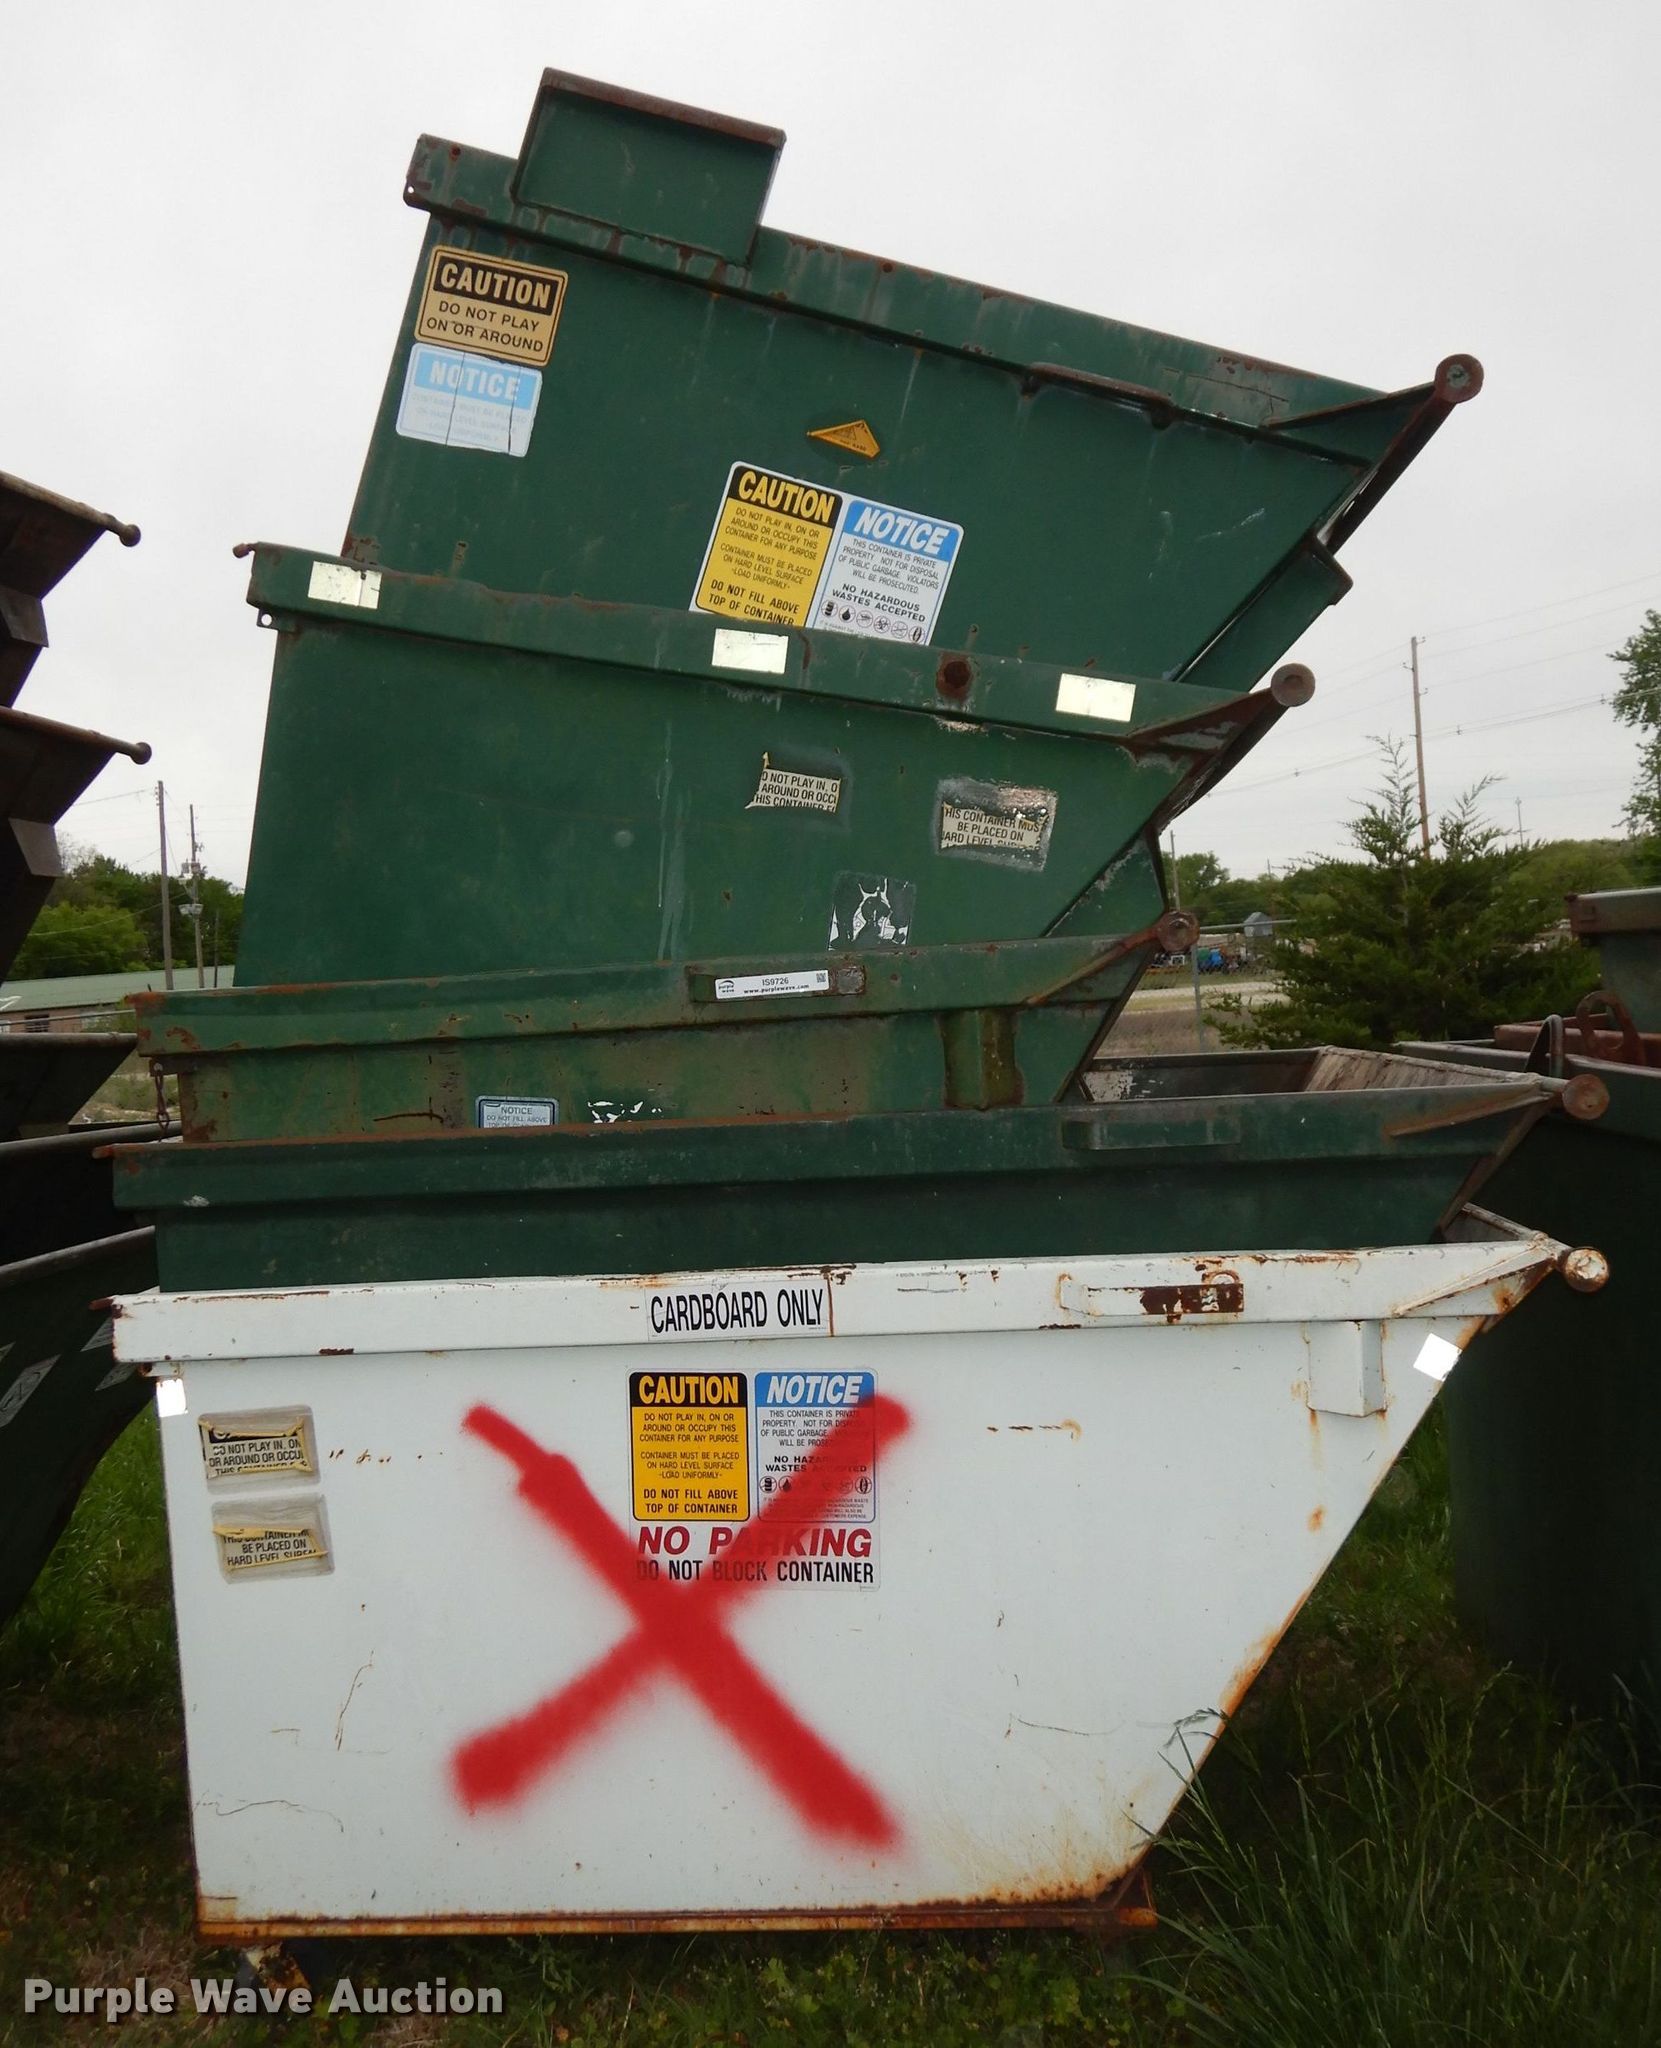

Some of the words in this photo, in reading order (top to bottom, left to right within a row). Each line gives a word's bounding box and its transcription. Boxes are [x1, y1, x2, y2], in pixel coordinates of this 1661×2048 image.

[440, 263, 551, 308] CAUTION
[439, 301, 460, 315] DO
[465, 306, 497, 323] NOT
[501, 314, 539, 332] PLAY
[426, 317, 448, 332] ON
[453, 323, 475, 337] OR
[479, 329, 543, 352] AROUND
[429, 360, 521, 401] NOTICE
[738, 470, 835, 523] CAUTION
[735, 507, 746, 516] DO
[748, 511, 763, 521] NOT
[765, 515, 782, 526] PLAY
[796, 525, 807, 535] ON
[809, 528, 820, 539] OR
[854, 506, 950, 555] NOTICE
[725, 525, 758, 542] CONTAINER
[760, 535, 772, 546] FOR
[774, 540, 787, 551] ANY
[789, 545, 818, 561] PURPOSE
[731, 518, 759, 531] AROUND
[761, 526, 771, 536] OR
[773, 529, 801, 544] OCCUPY
[803, 538, 818, 549] THIS
[720, 543, 755, 559] CONTAINER
[756, 552, 775, 564] MUST
[776, 560, 785, 569] BE
[787, 563, 813, 577] PLACED
[852, 538, 866, 549] THIS
[868, 542, 903, 561] CONTAINER
[904, 552, 911, 562] IS
[913, 554, 937, 569] PRIVATE
[723, 553, 733, 563] ON
[734, 557, 753, 569] HARD
[753, 562, 772, 575] LEVEL
[775, 569, 804, 585] SURFACE
[838, 554, 848, 563] OF
[849, 557, 870, 570] PUBLIC
[907, 574, 940, 590] VIOLATORS
[852, 569, 866, 580] WILL
[868, 573, 876, 582] BE
[880, 556, 894, 567] NOT
[895, 561, 908, 572] FOR
[909, 564, 939, 580] DISPOSAL
[710, 579, 724, 591] DO
[726, 584, 746, 598] NOT
[748, 591, 765, 605] FILL
[769, 598, 800, 615] ABOVE
[832, 589, 871, 607] WASTES
[875, 603, 926, 623] ACCEPTED
[842, 583, 857, 593] NO
[860, 588, 921, 613] HAZARDOUS
[708, 593, 726, 607] TOP
[729, 601, 741, 611] OF
[743, 605, 795, 625] CONTAINER
[769, 772, 789, 785] NOT
[790, 776, 814, 789] PLAY
[755, 794, 771, 805] HIS
[761, 783, 800, 798] AROUND
[801, 789, 815, 800] OR
[944, 808, 961, 819] HIS
[963, 810, 1016, 828] CONTAINER
[944, 831, 964, 843] ARD
[957, 821, 969, 832] BE
[971, 824, 1008, 839] PLACED
[1009, 830, 1024, 841] ON
[762, 977, 789, 986] IS9726
[500, 1106, 533, 1115] NOTICE
[651, 1291, 768, 1334] CARDBOARD
[777, 1289, 823, 1328] ONLY
[639, 1375, 739, 1405] CAUTION
[766, 1375, 863, 1404] NOTICE
[644, 1413, 655, 1421] DO
[658, 1413, 673, 1421] NOT
[676, 1413, 693, 1421] PLAY
[709, 1413, 720, 1421] ON
[723, 1413, 734, 1421] OR
[769, 1410, 784, 1418] THIS
[786, 1410, 823, 1418] CONTAINER
[826, 1410, 833, 1418] IS
[803, 1420, 816, 1428] NOT
[820, 1420, 833, 1428] FOR
[639, 1434, 675, 1442] CONTAINER
[677, 1434, 691, 1442] FOR
[693, 1434, 706, 1442] ANY
[709, 1434, 739, 1442] PURPOSE
[643, 1424, 672, 1432] AROUND
[675, 1424, 684, 1432] OR
[688, 1424, 717, 1432] OCCUPY
[720, 1424, 736, 1432] THIS
[760, 1429, 770, 1437] OF
[772, 1429, 795, 1437] PUBLIC
[228, 1443, 247, 1454] NOT
[248, 1441, 271, 1453] PLAY
[779, 1439, 794, 1447] WILL
[796, 1439, 805, 1447] BE
[208, 1457, 223, 1468] OR
[223, 1453, 260, 1466] AROUND
[262, 1452, 275, 1463] OR
[276, 1450, 304, 1461] OCCU
[640, 1451, 677, 1459] CONTAINER
[680, 1451, 699, 1459] MUST
[701, 1451, 711, 1459] BE
[713, 1451, 739, 1459] PLACED
[646, 1461, 657, 1469] ON
[659, 1461, 678, 1469] HARD
[680, 1461, 700, 1469] LEVEL
[703, 1461, 734, 1469] SURFACE
[774, 1455, 789, 1463] NO
[643, 1489, 656, 1499] DO
[661, 1489, 679, 1499] NOT
[685, 1489, 702, 1499] FILL
[707, 1489, 738, 1499] ABOVE
[645, 1503, 663, 1514] TOP
[668, 1503, 680, 1514] OF
[684, 1503, 738, 1514] CONTAINER
[242, 1543, 254, 1553] BE
[255, 1540, 291, 1552] PLACED
[293, 1539, 306, 1549] ON
[637, 1526, 691, 1555] NO
[227, 1554, 252, 1566] HARD
[637, 1560, 660, 1580] DO
[668, 1559, 703, 1581] NOT
[713, 1560, 767, 1582] BLOCK
[777, 1560, 874, 1584] CONTAINER
